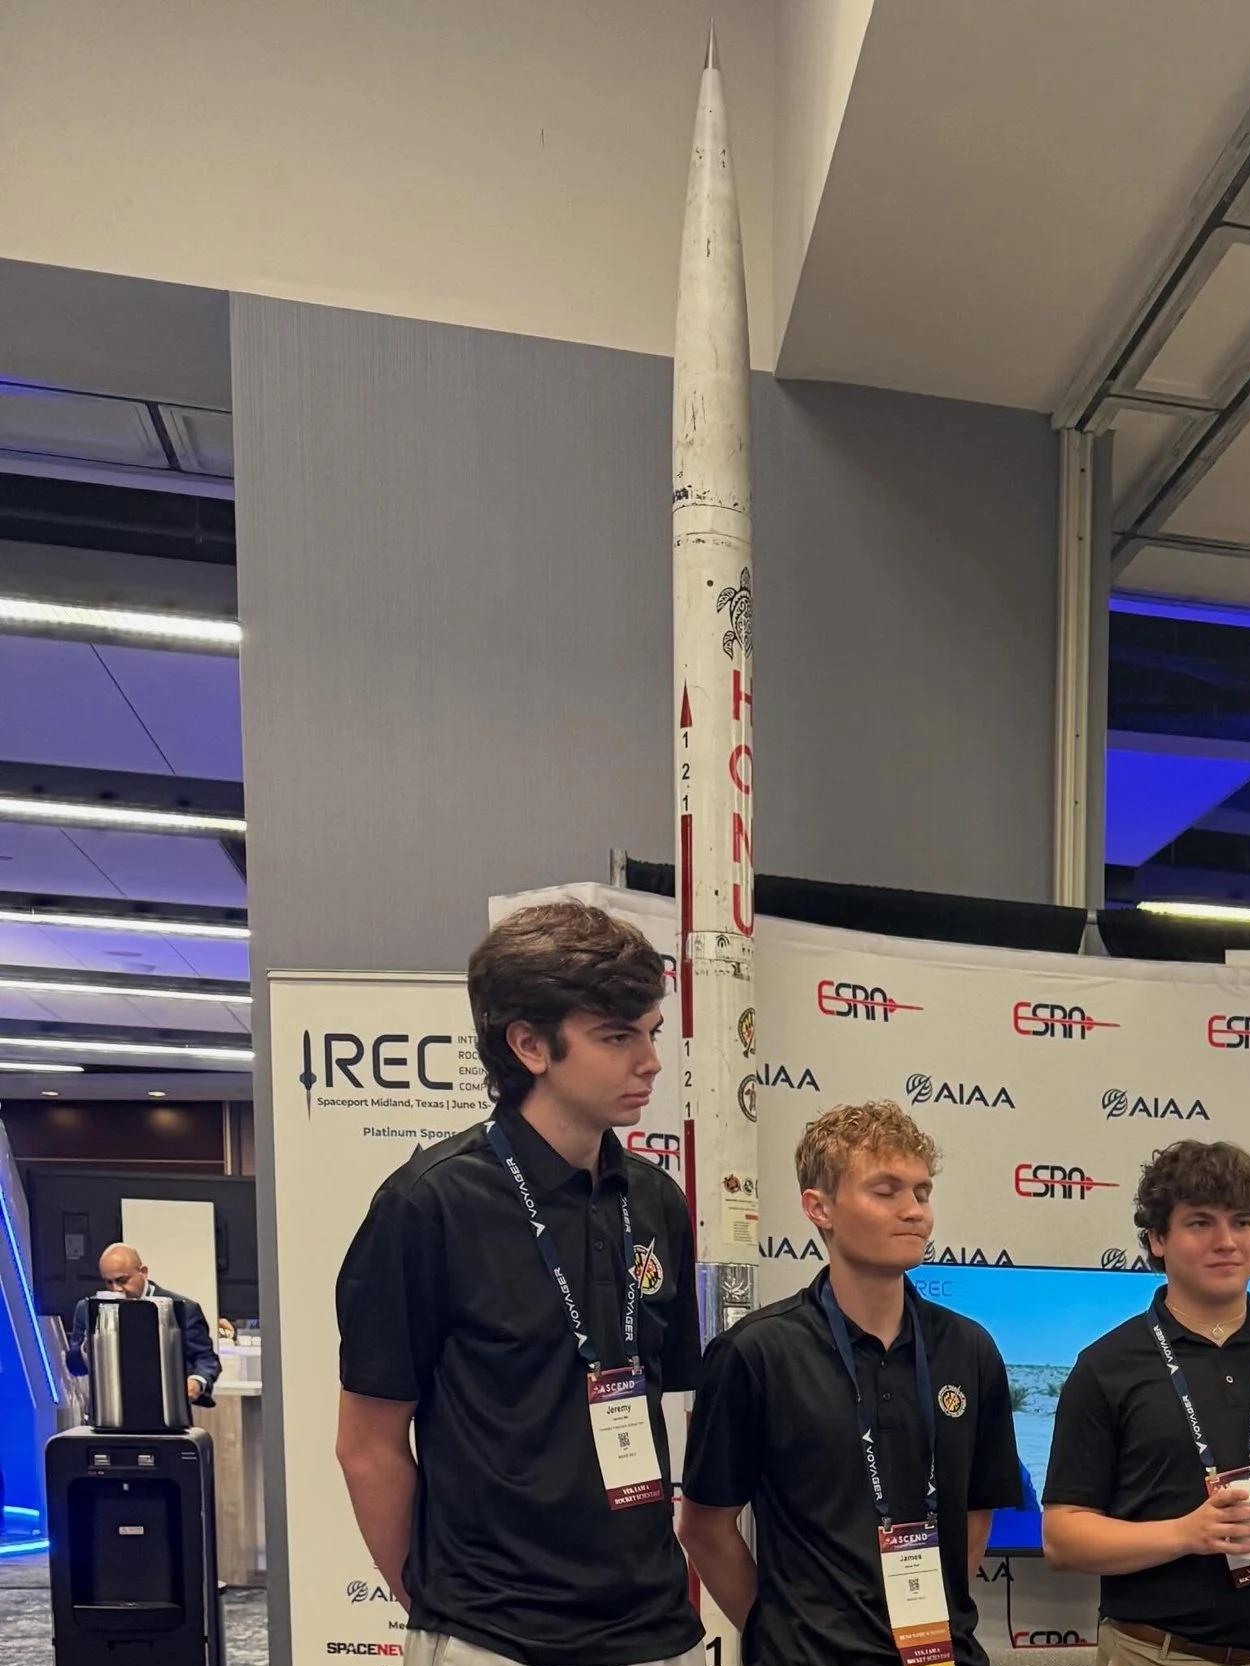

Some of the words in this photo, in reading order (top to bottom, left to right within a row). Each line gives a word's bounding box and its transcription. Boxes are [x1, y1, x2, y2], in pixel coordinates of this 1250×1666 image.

[459, 1052, 478, 1060] ROC
[459, 1083, 487, 1091] COMP
[934, 1082, 1015, 1109] AIAA
[317, 1098, 368, 1108] Spaceport
[371, 1098, 414, 1109] Midland,
[416, 1100, 444, 1108] Texas
[452, 1101, 476, 1109] June
[1128, 1096, 1210, 1120] AIAA
[363, 1127, 417, 1137] Platinum
[505, 1157, 537, 1218] VOYAGER
[915, 1280, 952, 1297] REC
[554, 1267, 581, 1329] VOYAGER
[625, 1282, 638, 1342] VOYAGER
[598, 1380, 635, 1393] ASCEND
[606, 1405, 631, 1415] Jeremy
[866, 1446, 883, 1500] VOYAGER
[889, 1533, 927, 1544] ASCEND
